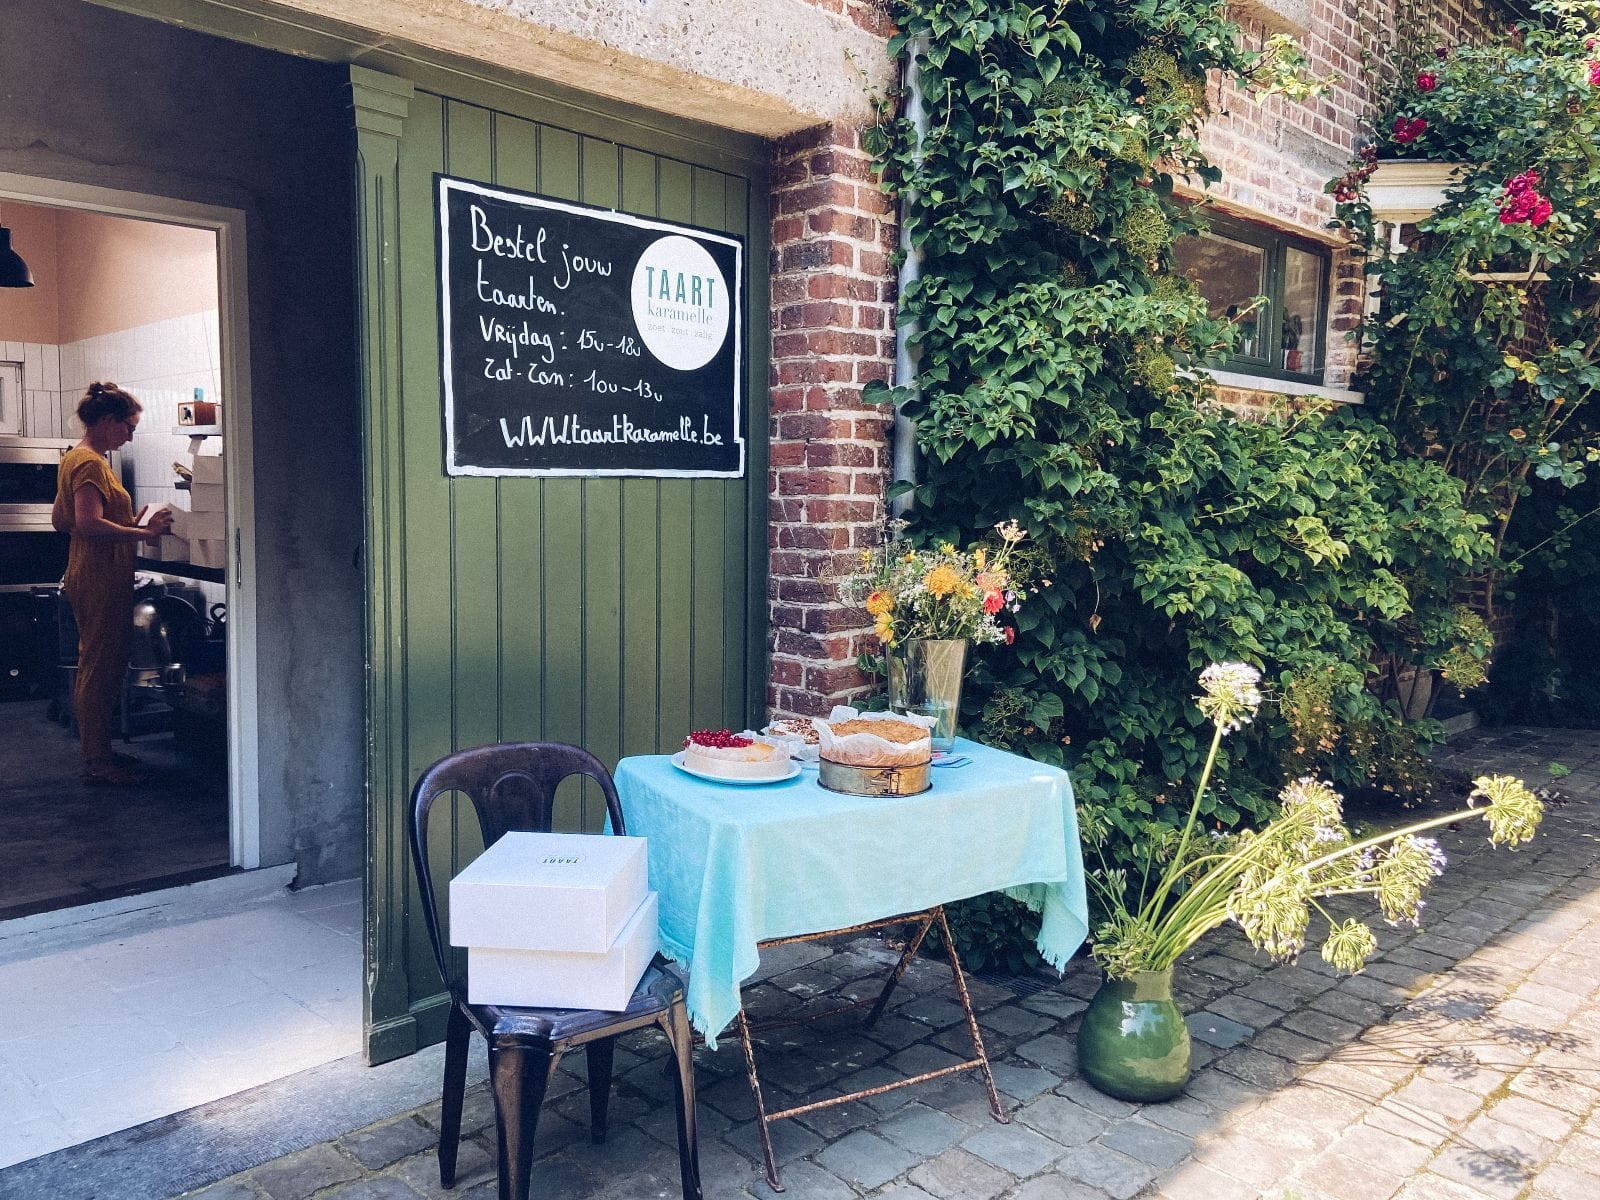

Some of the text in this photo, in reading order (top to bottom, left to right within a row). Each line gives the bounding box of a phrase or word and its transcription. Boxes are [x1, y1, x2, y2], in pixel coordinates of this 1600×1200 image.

[470, 204, 612, 290] Bestel jouw
[476, 258, 566, 316] taarten.
[645, 265, 715, 309] TAART
[648, 299, 713, 325] karamelle
